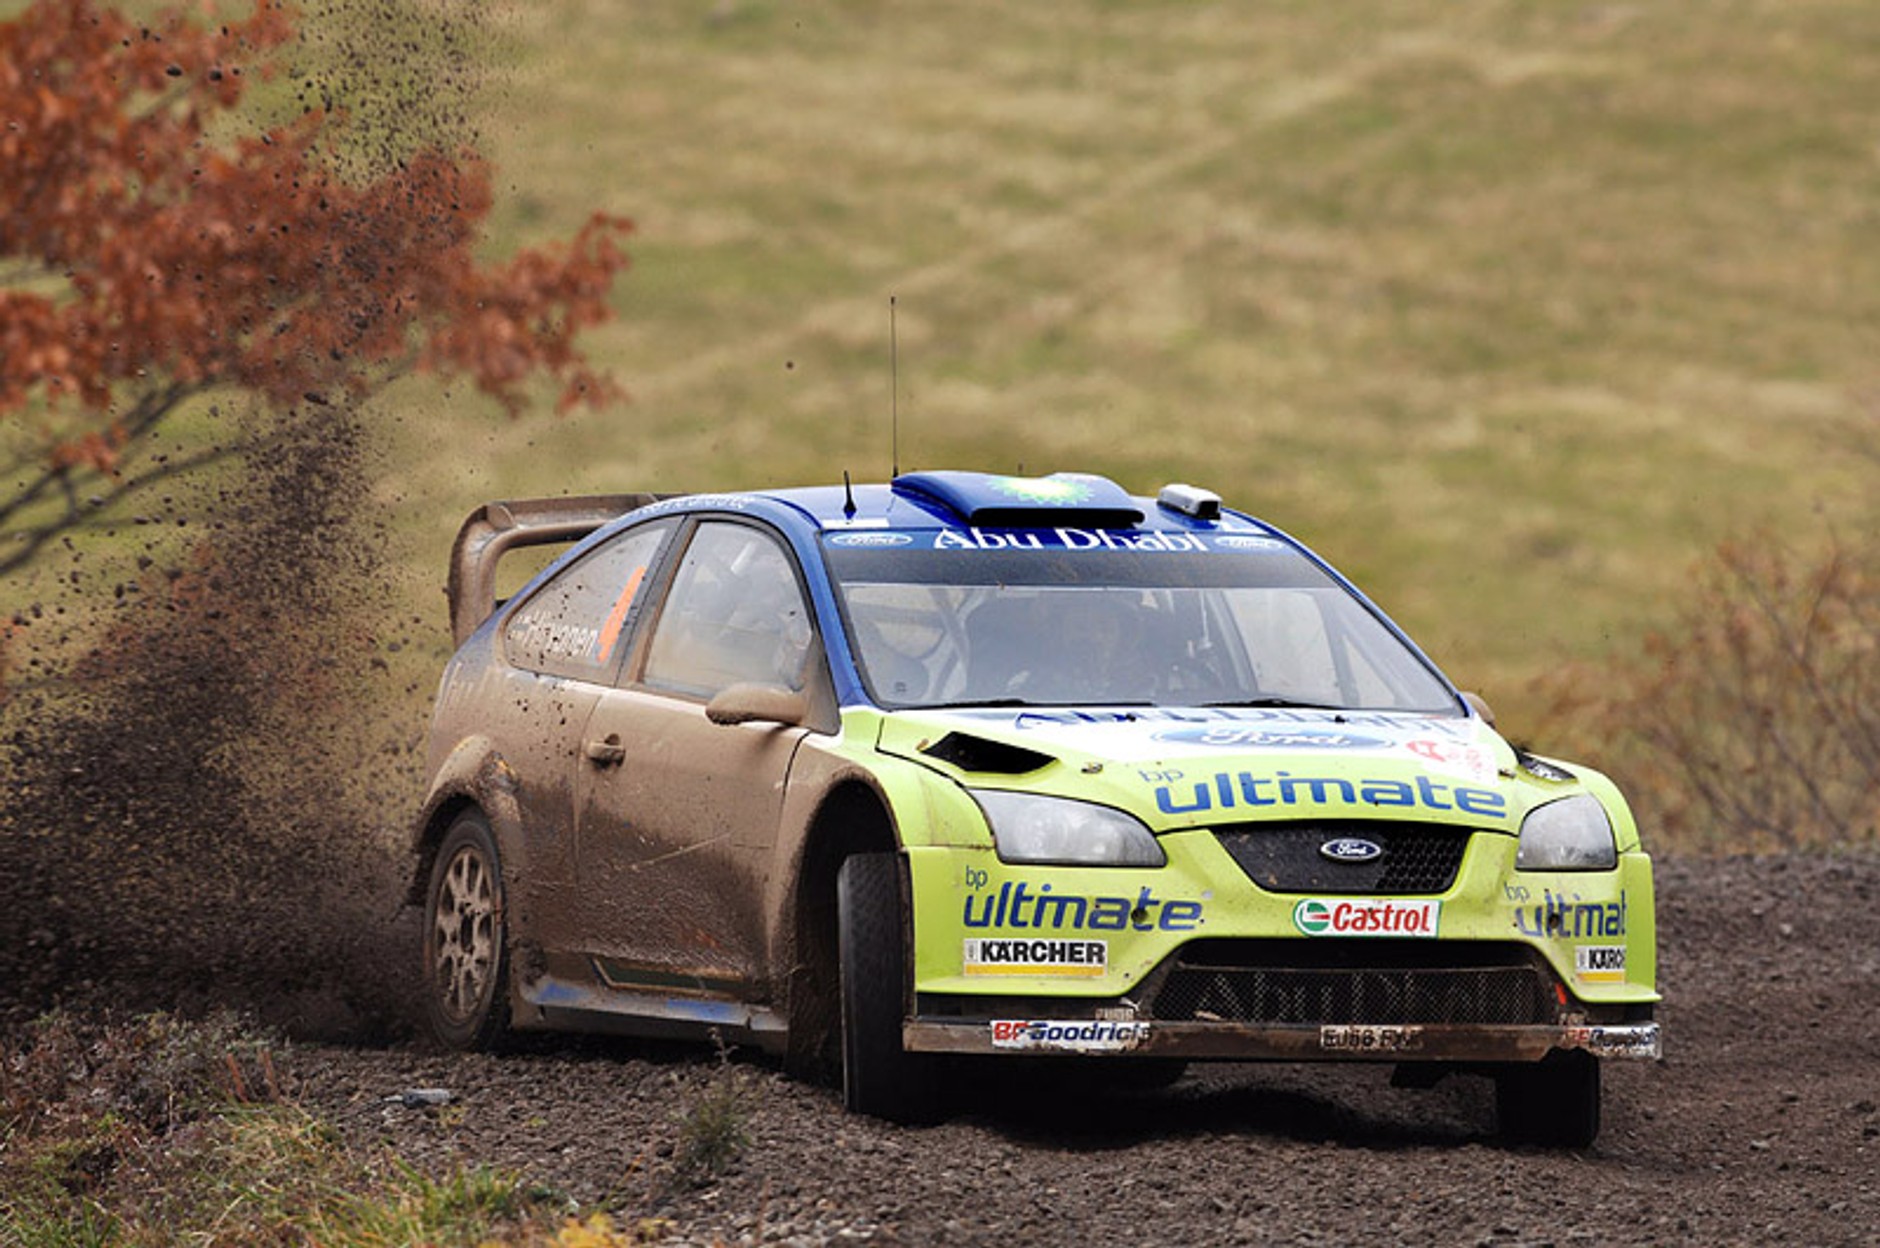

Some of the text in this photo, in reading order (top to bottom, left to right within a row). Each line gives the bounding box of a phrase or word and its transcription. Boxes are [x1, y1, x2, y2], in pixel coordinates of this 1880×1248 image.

[933, 527, 1209, 551] Abu Dhabi
[1201, 728, 1353, 747] Ford
[1138, 768, 1184, 785] bp
[1154, 771, 1506, 819] ultimate
[965, 865, 988, 891] bp
[963, 881, 1204, 931] ultimate
[1333, 902, 1430, 933] Castrol
[981, 940, 1106, 963] KÄRCHER
